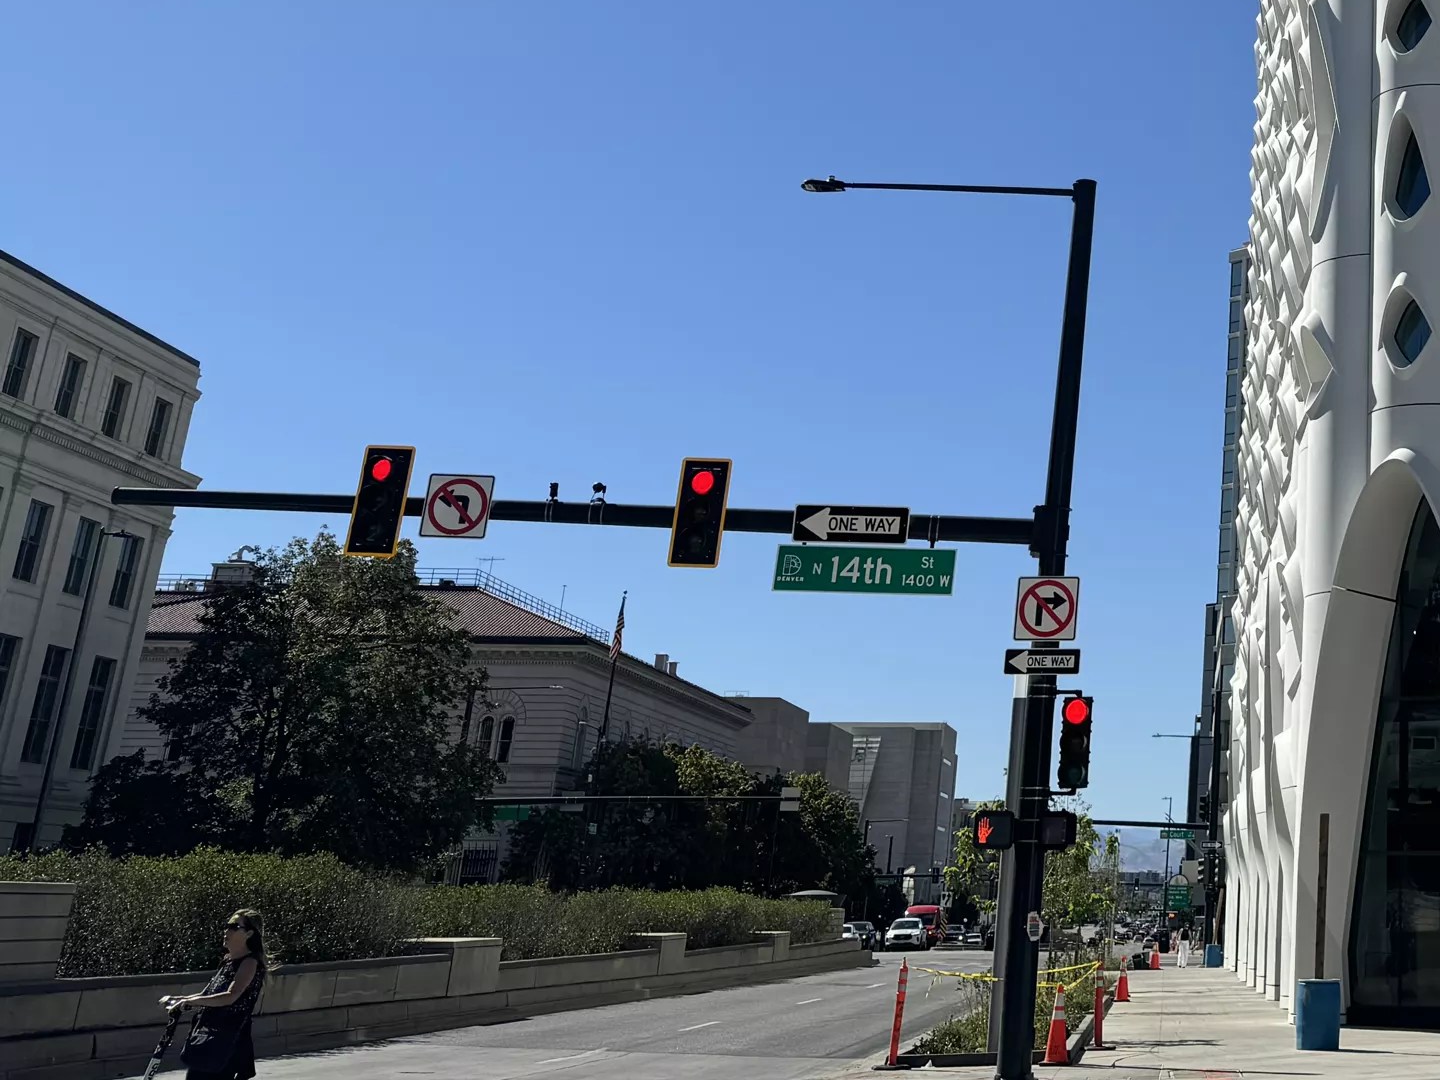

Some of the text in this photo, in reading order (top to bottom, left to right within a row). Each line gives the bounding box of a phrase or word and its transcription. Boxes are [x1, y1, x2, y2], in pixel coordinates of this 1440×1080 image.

[828, 516, 896, 532] ONE WAY
[812, 555, 935, 585] N 14th St
[901, 574, 950, 588] 1400 W
[1027, 656, 1072, 667] ONE WAY
